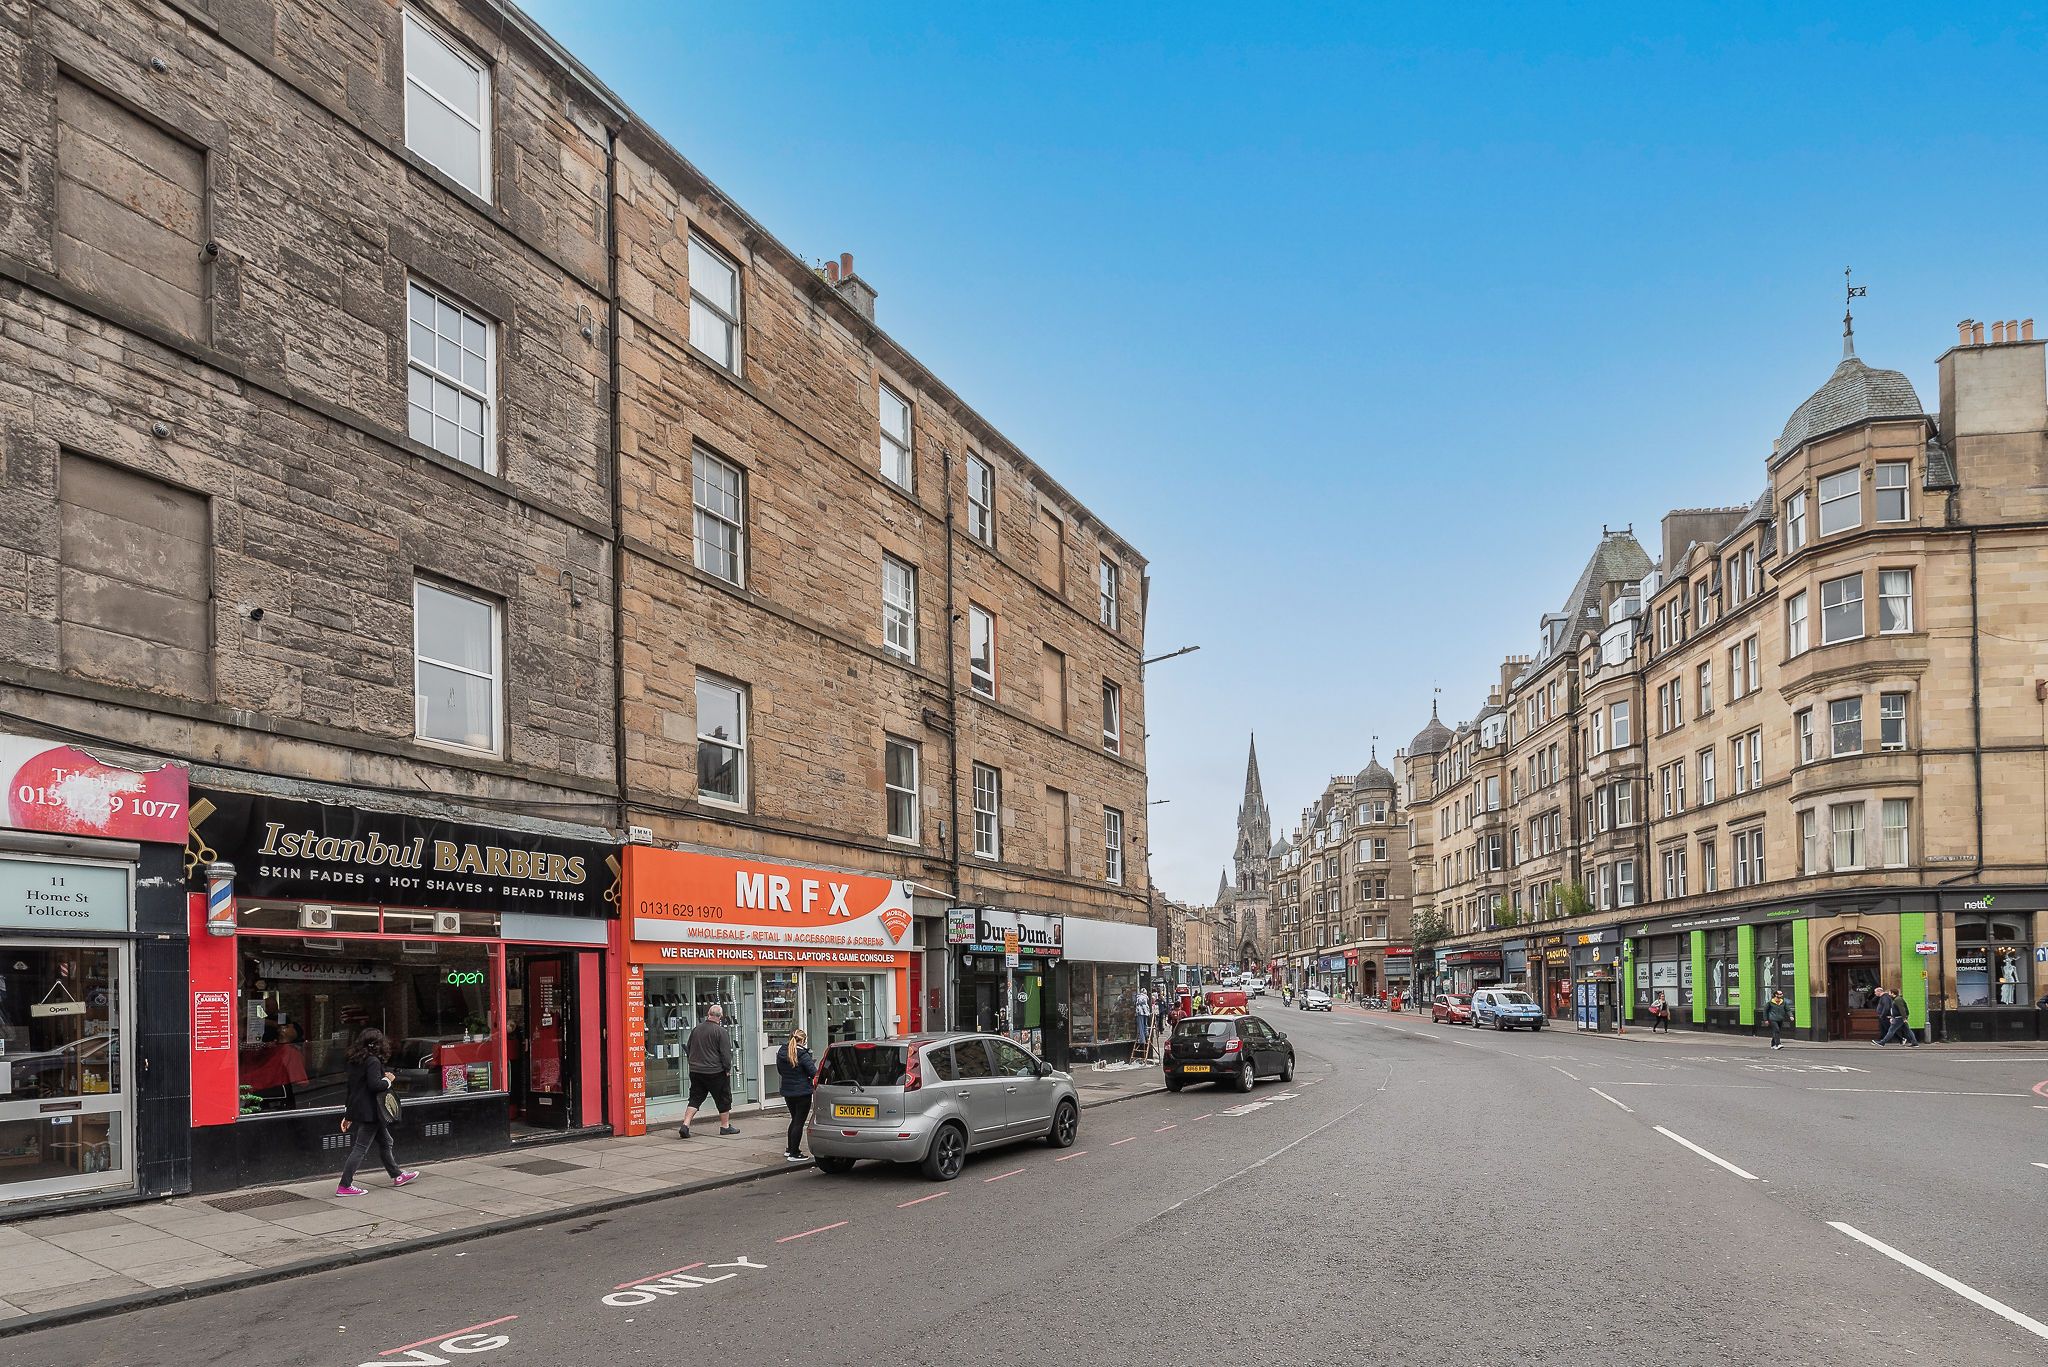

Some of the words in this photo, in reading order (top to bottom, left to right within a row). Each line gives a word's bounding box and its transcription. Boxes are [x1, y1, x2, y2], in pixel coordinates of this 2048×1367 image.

[131, 799, 180, 819] 1077
[258, 822, 425, 869] Istanbul
[434, 840, 587, 885] BARBERS
[51, 876, 65, 887] 11
[259, 866, 301, 879] SKIN
[309, 870, 365, 884] FADES
[389, 877, 420, 889] HOT
[426, 880, 482, 893] SHAVES
[502, 887, 544, 898] BEARD
[549, 890, 585, 901] TRIMS
[26, 890, 71, 902] Home
[76, 893, 89, 903] St
[736, 870, 793, 912] MR
[25, 905, 90, 918] Tollcross
[640, 901, 669, 915] 0131
[672, 903, 694, 917] 629
[696, 905, 723, 918] 1970
[1964, 900, 1988, 909] nettl
[687, 927, 745, 939] WHOLESALE
[752, 930, 781, 941] RETAIL
[784, 933, 793, 942] IN
[795, 934, 846, 945] ACCESSORIES
[847, 936, 853, 945] &
[854, 936, 885, 946] SCREENS
[1018, 923, 1052, 944] Dum's
[661, 947, 678, 957] WE
[680, 948, 715, 959] REPAIR
[717, 949, 756, 961] PHONES,
[757, 951, 796, 961] TABLETS,
[797, 952, 831, 961] LAPTOPS
[831, 953, 838, 962] &
[838, 953, 859, 962] GAME
[860, 954, 895, 963] CONSOLES
[1546, 948, 1567, 960] TAQUITO
[447, 970, 484, 987] open
[50, 1006, 69, 1014] Open
[839, 1106, 855, 1115] SK10
[856, 1107, 871, 1116] RVE
[602, 1255, 768, 1308] ONLY
